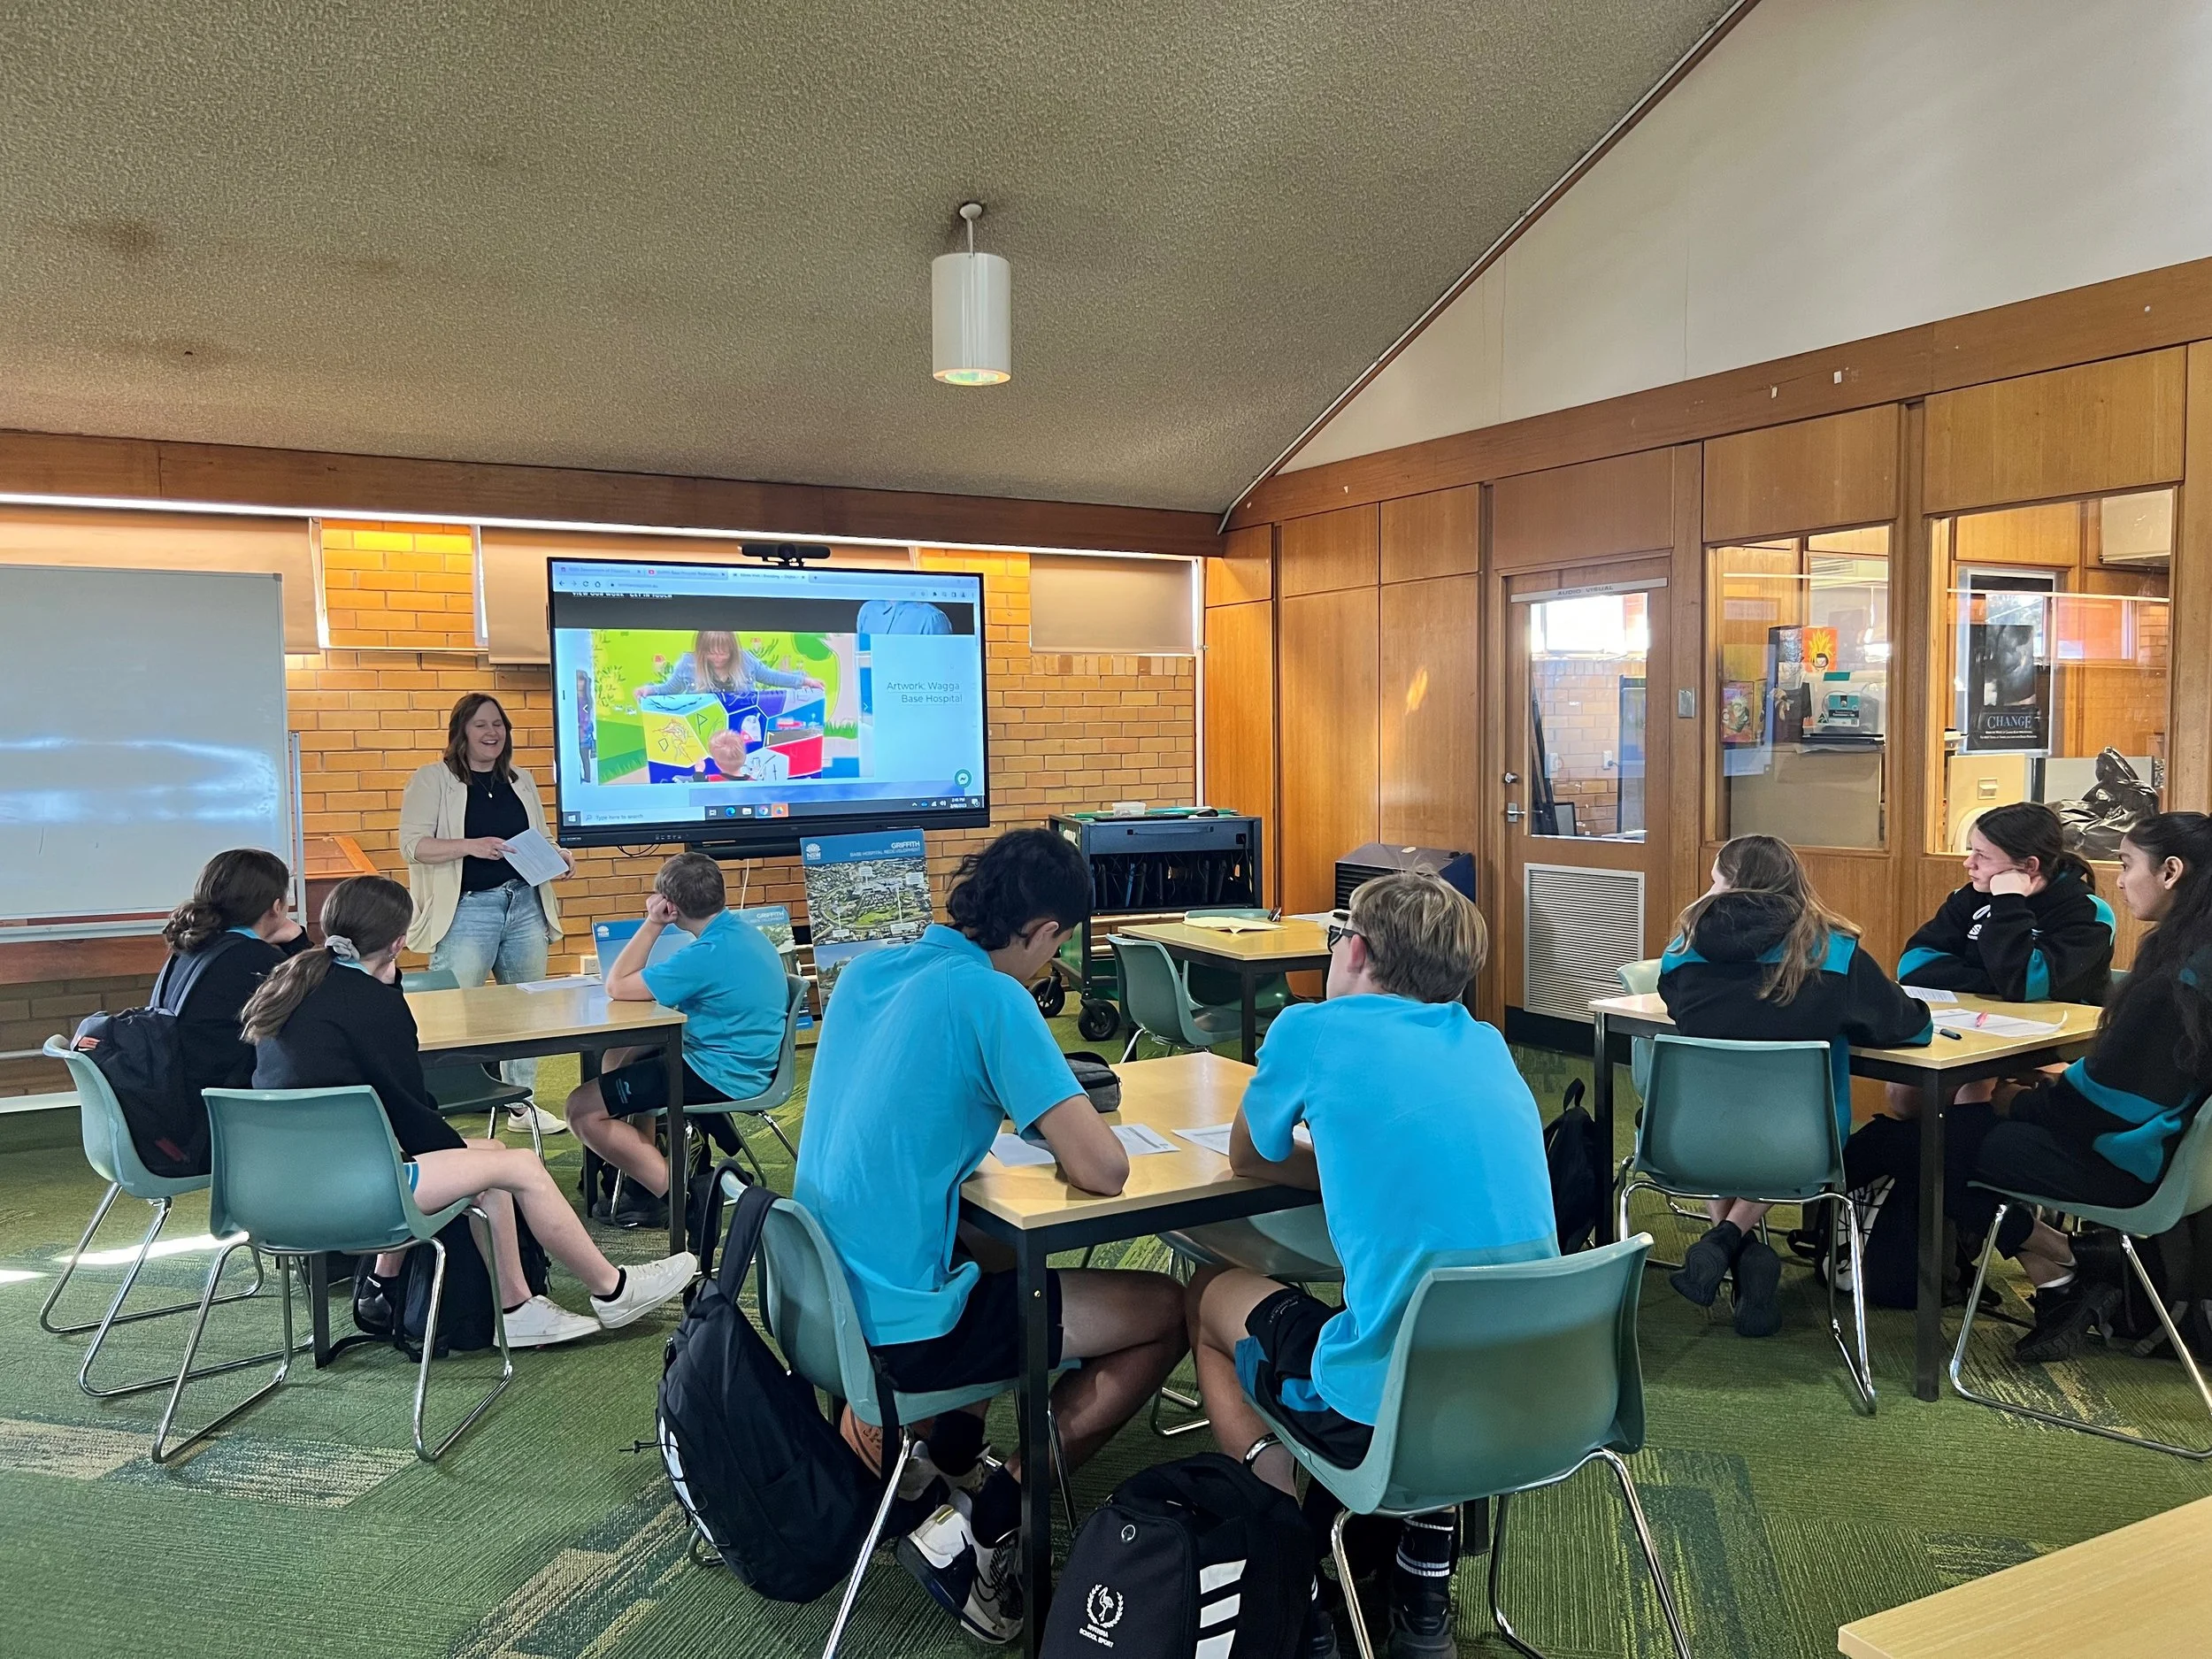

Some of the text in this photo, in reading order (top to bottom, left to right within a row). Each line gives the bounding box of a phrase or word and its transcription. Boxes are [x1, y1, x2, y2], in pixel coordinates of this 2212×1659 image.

[927, 681, 960, 691] Wagga
[902, 694, 963, 703] Base Hospital
[1986, 715, 2032, 729] CHANGE
[1097, 1636, 1114, 1648] SPORT
